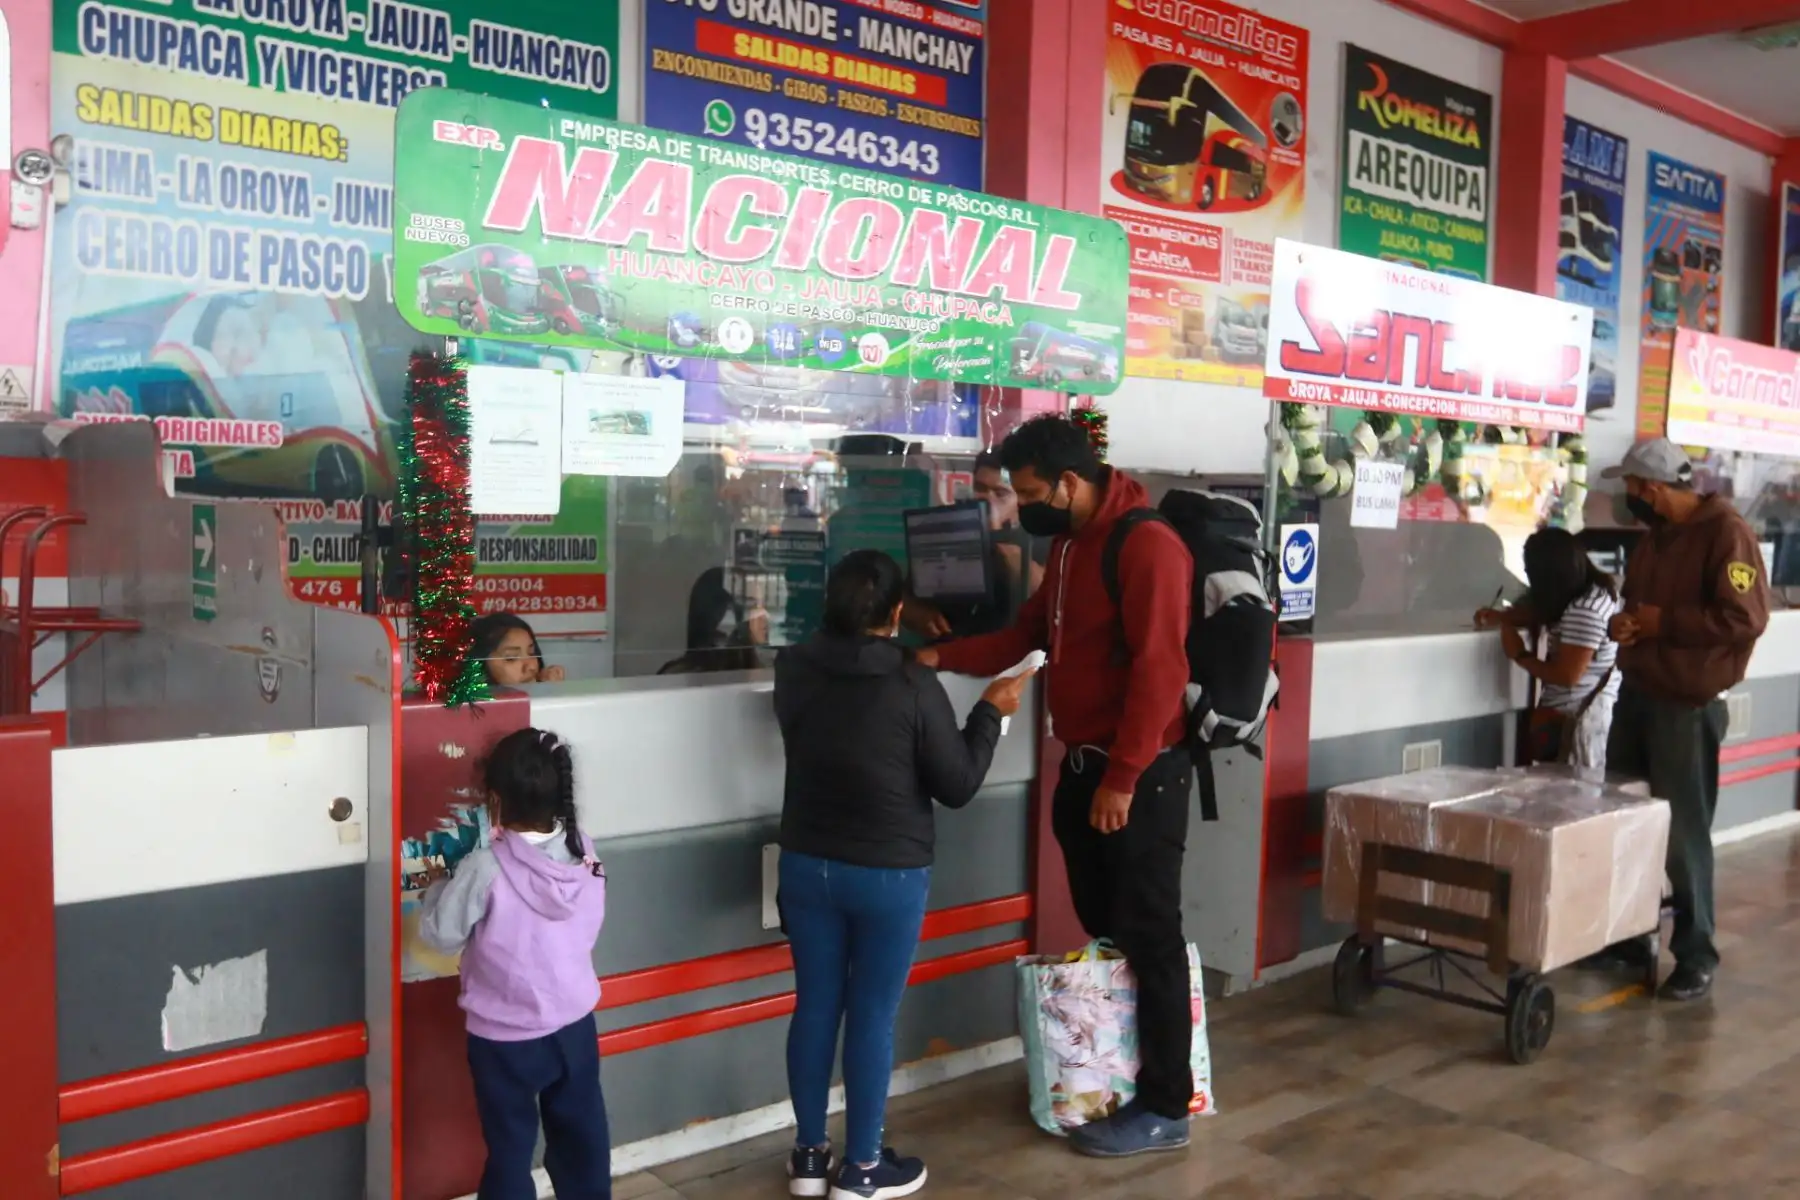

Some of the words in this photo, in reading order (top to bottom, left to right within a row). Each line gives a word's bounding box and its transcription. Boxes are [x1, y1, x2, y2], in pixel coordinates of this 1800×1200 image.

[82, 6, 245, 81] CHUPACA
[258, 40, 278, 85] Y
[368, 1, 450, 57] JAUJA
[471, 23, 607, 90] HUANCAYO
[728, 0, 838, 42] GRANDE
[858, 15, 976, 76] MANCHAY
[733, 31, 830, 75] SALIDAS
[833, 56, 917, 95] DIARIAS
[1112, 22, 1173, 52] PASAJES
[1176, 42, 1187, 57] A
[1189, 48, 1227, 69] JAUJA
[1237, 60, 1301, 91] HUANCAYO
[76, 83, 214, 141] SALIDAS
[218, 106, 348, 162] DIARIAS:
[432, 118, 506, 152] EXP.
[783, 77, 828, 105] GIROS
[837, 89, 889, 118] PASEOS
[896, 102, 982, 138] ESCURSIONES
[1357, 62, 1481, 149] ROMELIZA
[560, 119, 662, 155] EMPRESA
[665, 135, 693, 160] DE
[698, 146, 831, 185] TRANSPORTES
[839, 173, 904, 200] CERRO
[908, 186, 933, 205] DE
[936, 191, 993, 217] PASCO
[743, 107, 940, 176] 935246343
[1355, 138, 1482, 213] AREQUIPA
[77, 144, 154, 199] LIMA
[179, 158, 213, 207] LA
[219, 165, 311, 219] OROYA
[331, 182, 394, 230] JUNI
[1343, 196, 1363, 215] ICA
[76, 211, 200, 279] CERRO
[208, 228, 250, 283] DE
[259, 233, 368, 295] PASCO
[404, 227, 470, 247] NUEVOS
[411, 213, 465, 232] BUSES
[481, 134, 1083, 312] NACIONAL
[606, 248, 776, 294] HUANCAYO
[799, 277, 883, 309] JAUJA
[904, 290, 1014, 327] CHUPACA
[1134, 247, 1193, 271] CARGA
[709, 293, 771, 314] CERRO
[802, 304, 854, 324] PASCO
[866, 312, 941, 333] HUANUCO
[1338, 384, 1379, 408] JAUJA
[479, 536, 598, 562] RESPONSABILIDAD
[480, 594, 599, 613] #942833934
